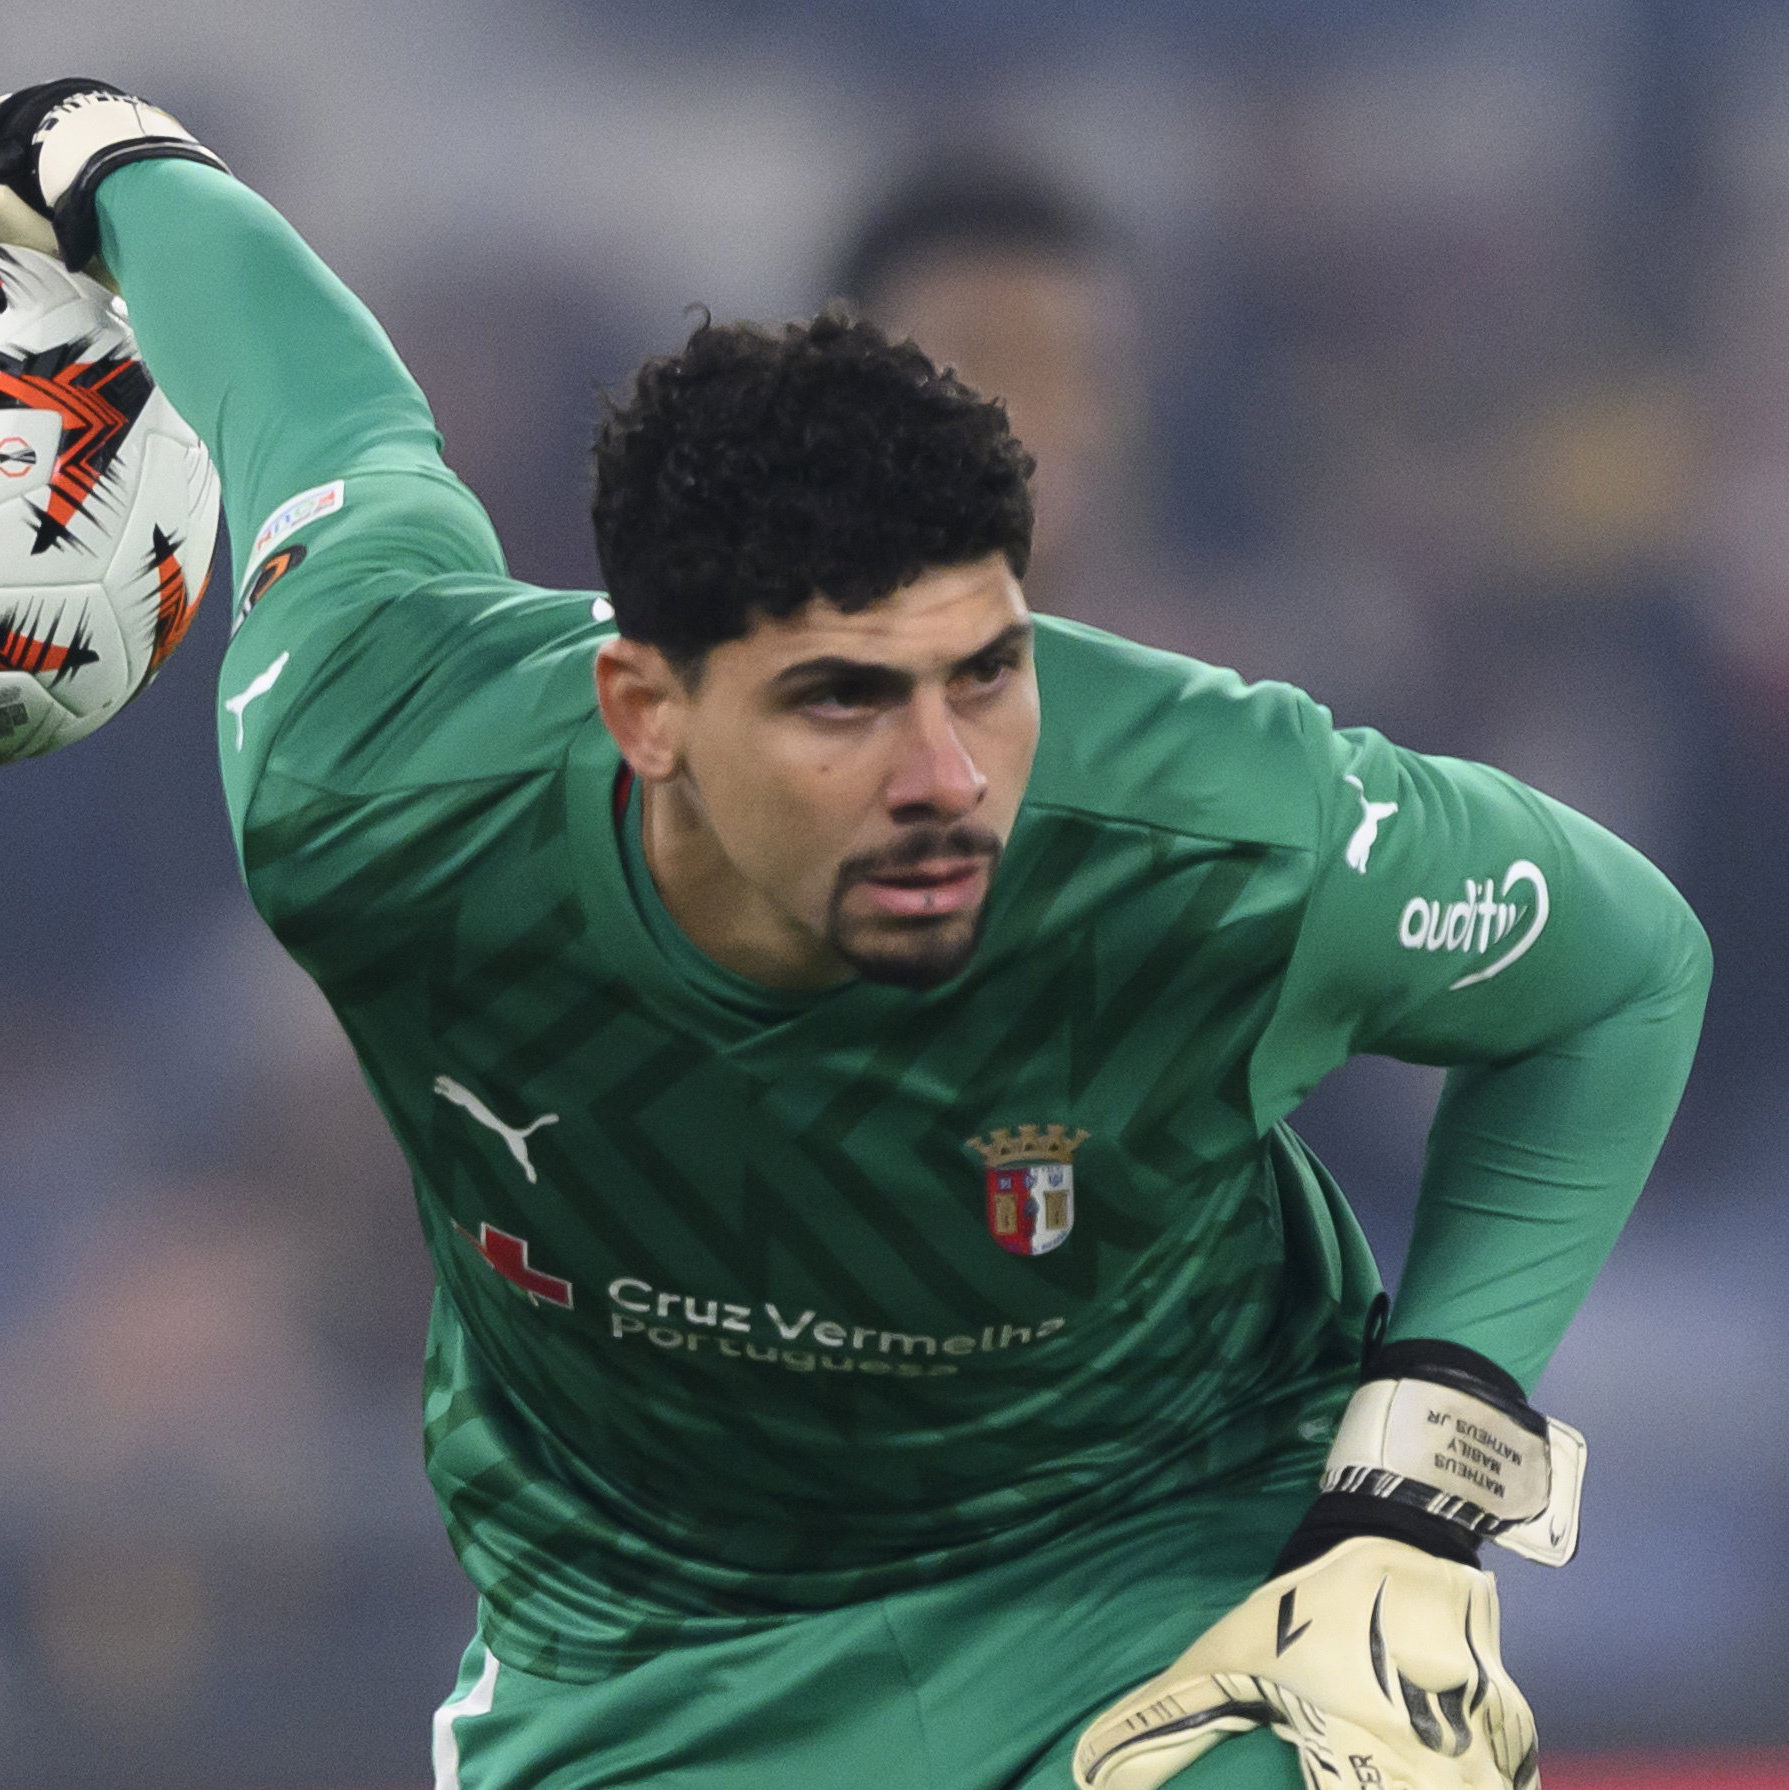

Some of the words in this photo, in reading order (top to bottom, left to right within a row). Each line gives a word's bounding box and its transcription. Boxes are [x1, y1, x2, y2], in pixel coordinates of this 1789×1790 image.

[607, 1277, 752, 1333] Cruz
[764, 1302, 1067, 1358] Vermelha
[610, 1312, 960, 1378] Portuguesa
[1427, 1410, 1451, 1426] JR
[1456, 1419, 1522, 1465] MATHEUS
[1435, 1454, 1505, 1498] MATHEUS
